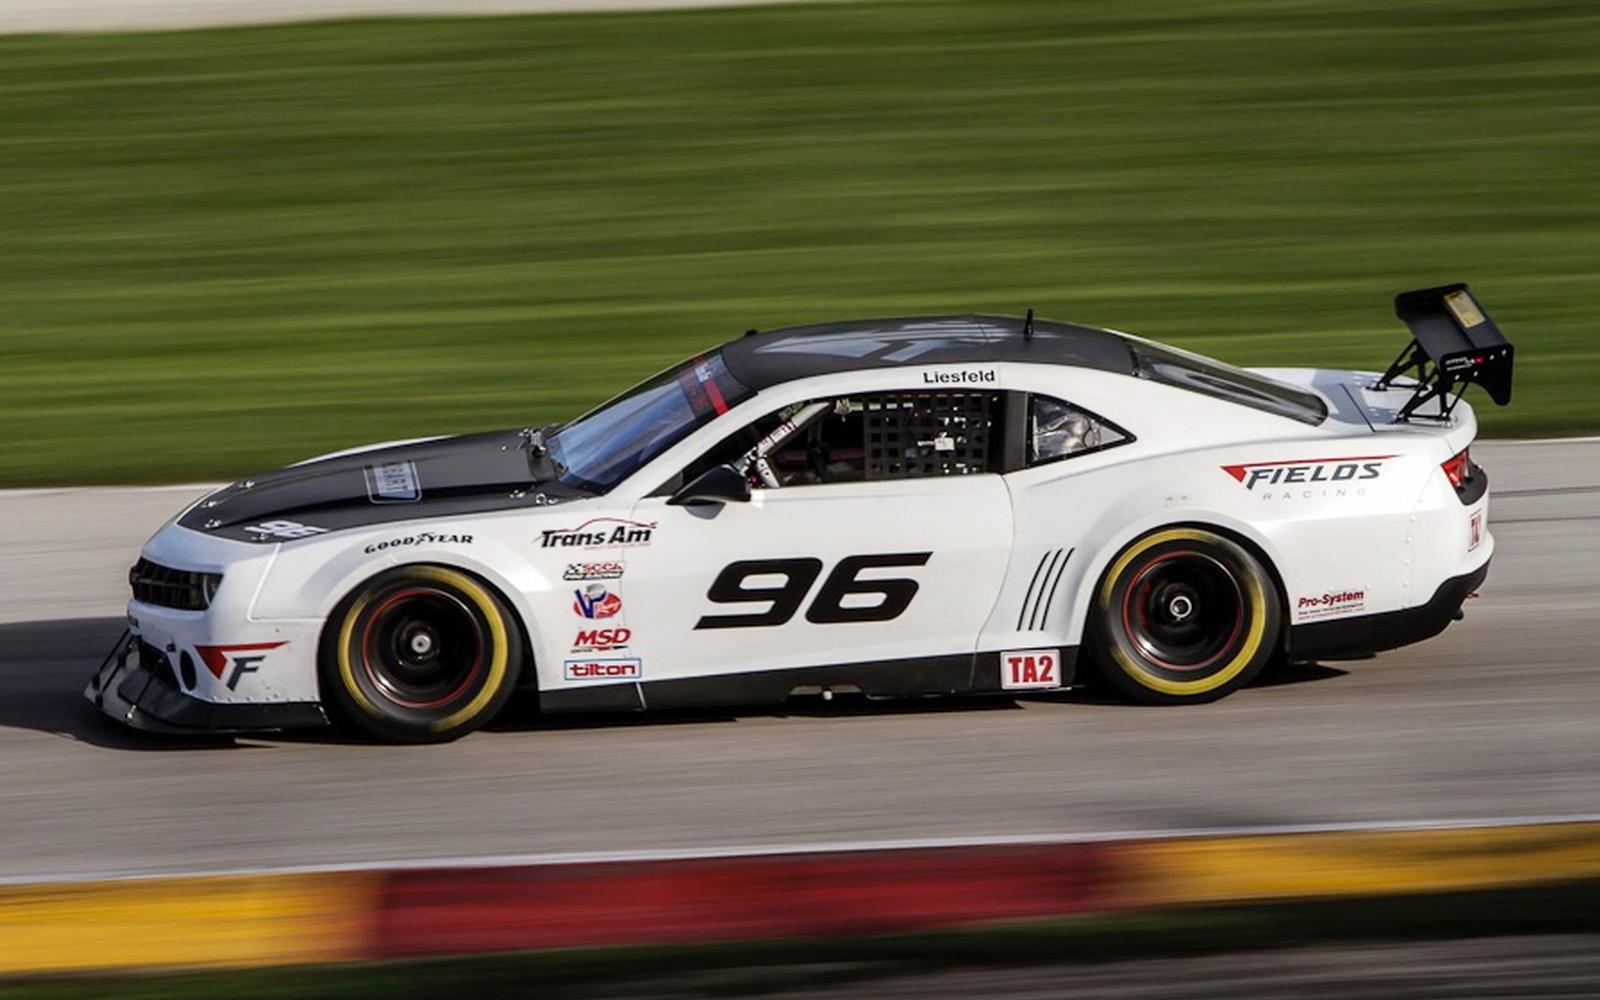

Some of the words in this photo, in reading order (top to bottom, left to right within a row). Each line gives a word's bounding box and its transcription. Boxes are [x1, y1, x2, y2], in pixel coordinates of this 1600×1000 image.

[923, 370, 995, 383] Liesfeld
[1246, 462, 1382, 491] FIELDS
[1262, 488, 1366, 500] RACING
[541, 529, 606, 548] Trans
[607, 526, 652, 543] Am
[692, 551, 933, 630] 96
[1298, 591, 1364, 608] Pro-System
[574, 628, 631, 646] MSD
[570, 663, 635, 676] tilton
[1007, 655, 1053, 683] TA2
